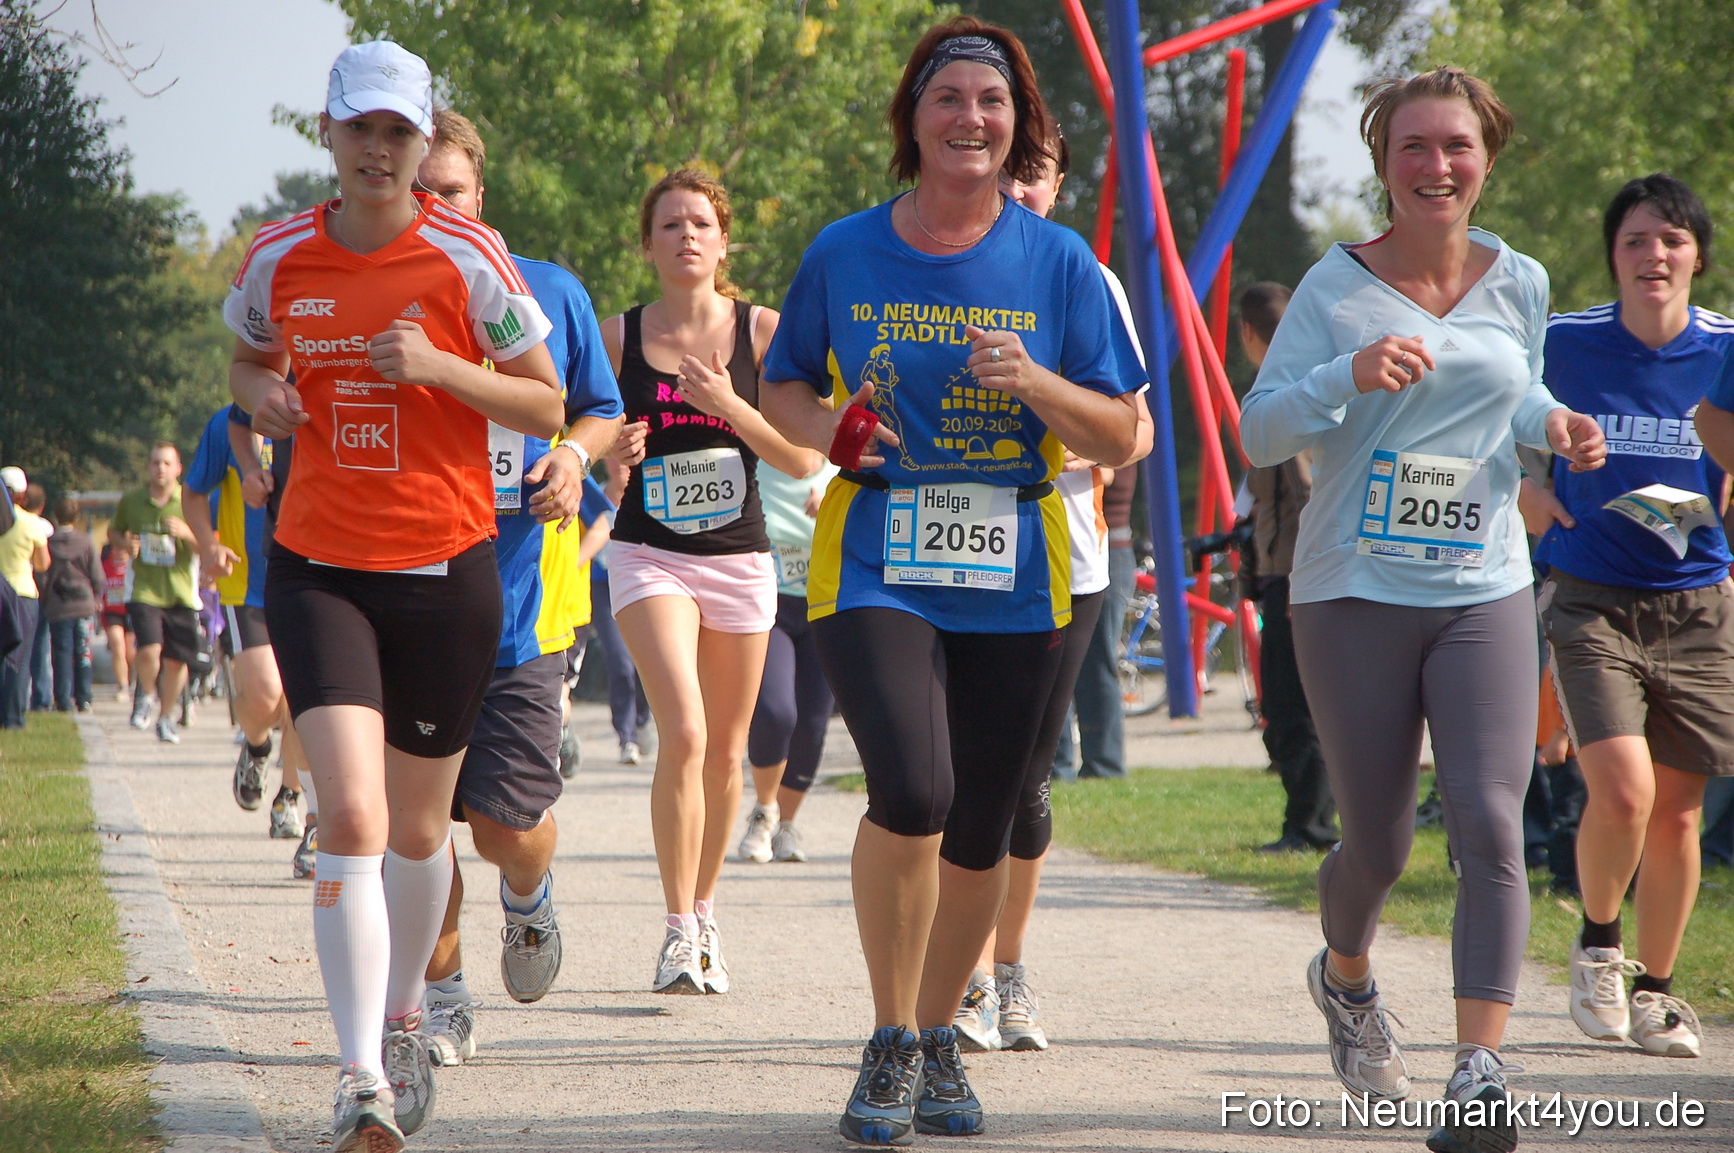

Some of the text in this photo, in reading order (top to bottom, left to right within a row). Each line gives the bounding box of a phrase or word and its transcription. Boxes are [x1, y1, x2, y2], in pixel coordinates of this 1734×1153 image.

[289, 299, 335, 316] DAK
[850, 303, 1037, 331] 10. NEUMARKTER
[310, 359, 363, 369] Nürnberger
[341, 422, 390, 449] GfK
[1606, 441, 1699, 457] TECHNOLOGY
[670, 459, 716, 477] Melanie
[1400, 462, 1455, 487] Karina
[495, 493, 519, 502] DERER
[651, 488, 658, 499] D
[674, 479, 734, 507] 2263
[924, 488, 970, 514] Helga
[1368, 490, 1377, 506] D
[1397, 496, 1482, 532] 2055
[892, 519, 900, 534] D
[924, 521, 1006, 555] 2056
[967, 571, 1014, 584] PFLEIDERER
